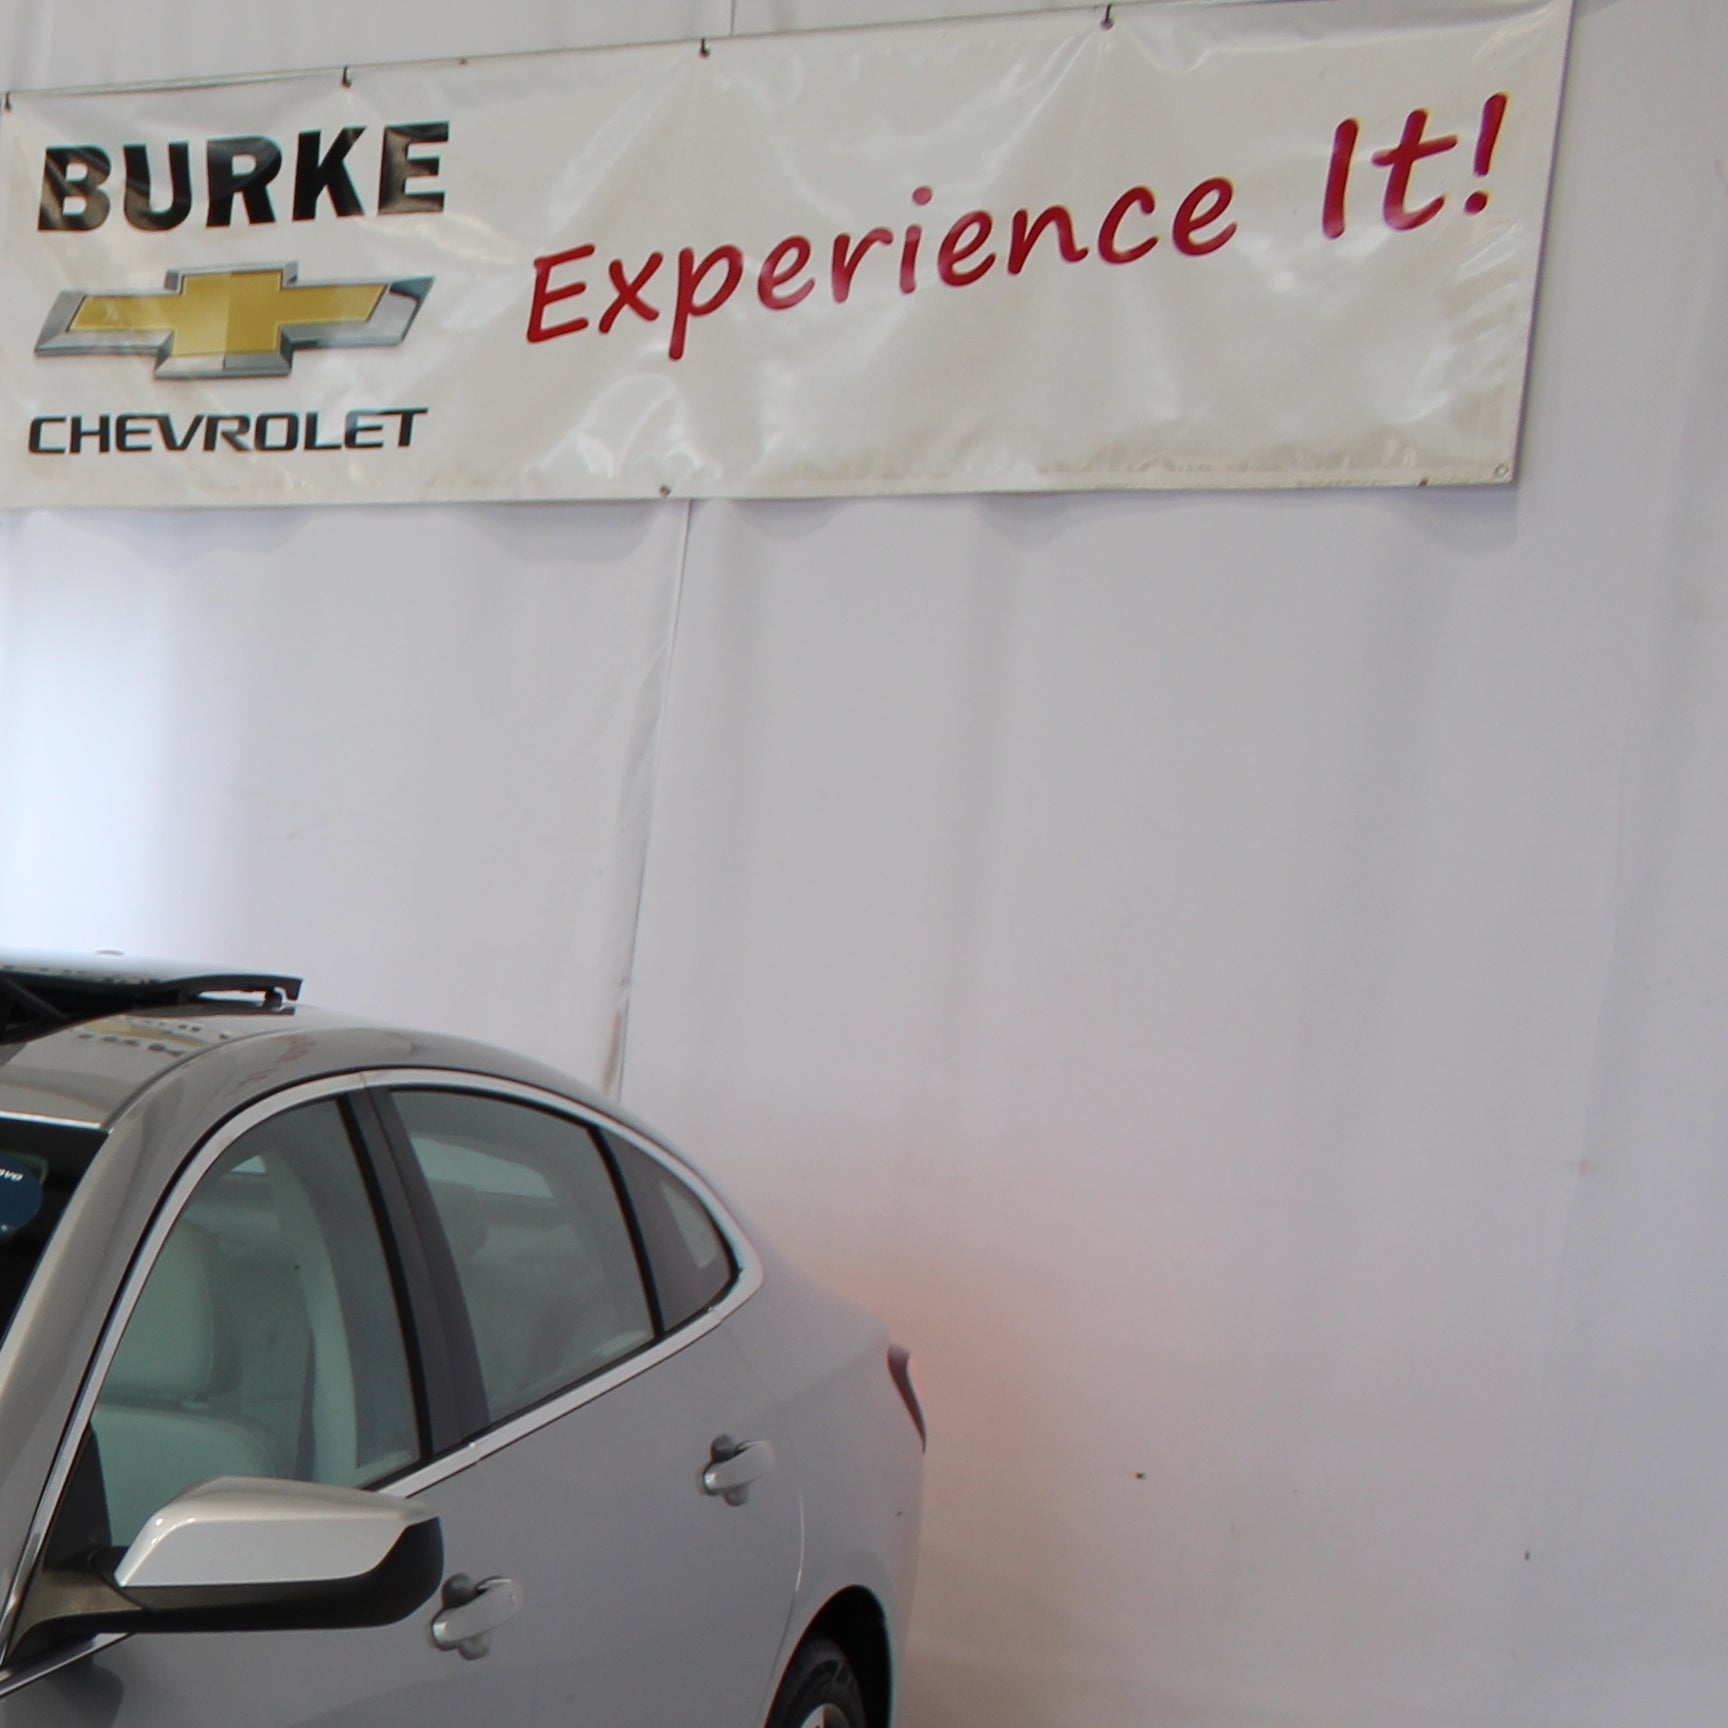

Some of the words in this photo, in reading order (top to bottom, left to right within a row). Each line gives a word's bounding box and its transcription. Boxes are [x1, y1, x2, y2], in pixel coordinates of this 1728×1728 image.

[36, 120, 450, 232] BURKE
[524, 176, 1239, 361] Experience
[1320, 92, 1508, 240] It!
[27, 406, 430, 455] CHEVROLET
